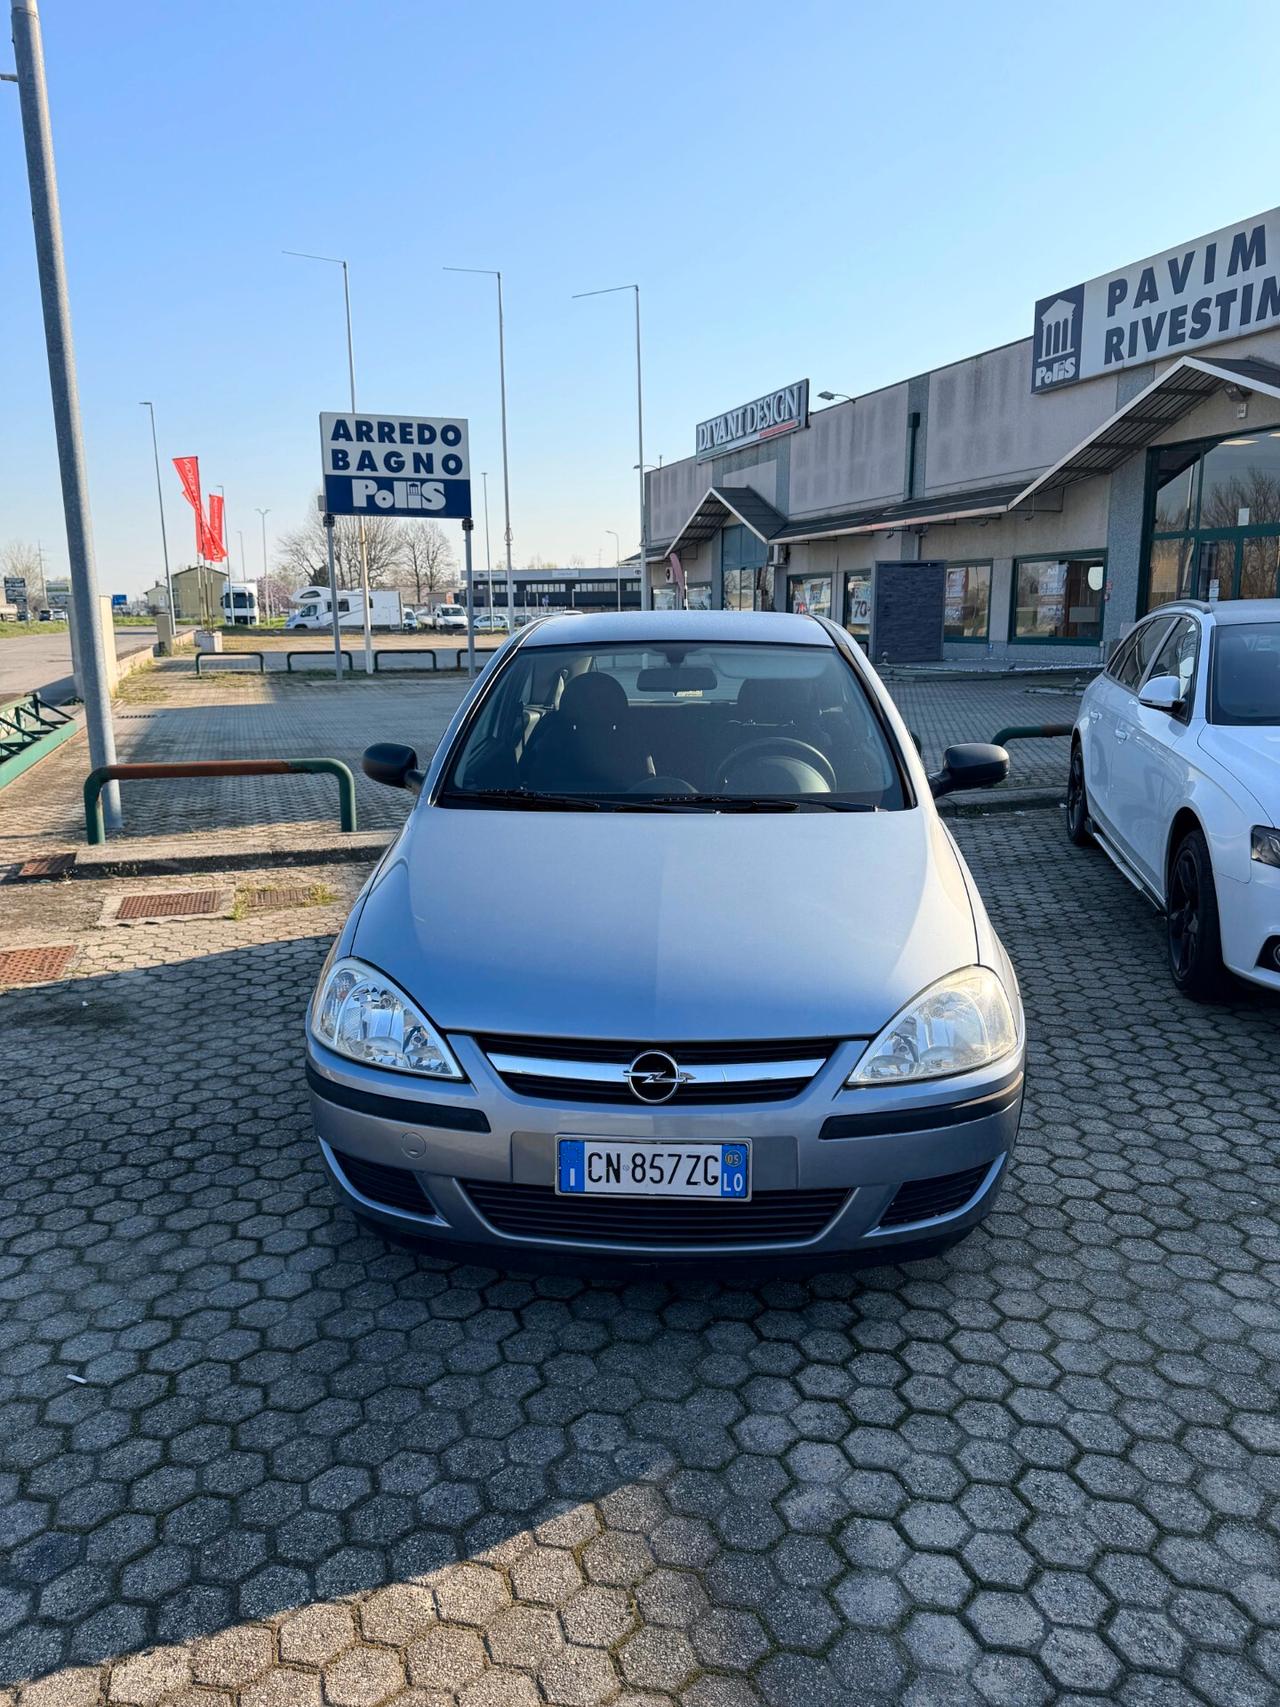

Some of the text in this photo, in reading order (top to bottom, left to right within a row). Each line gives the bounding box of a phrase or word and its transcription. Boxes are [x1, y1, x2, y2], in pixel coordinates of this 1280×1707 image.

[1106, 224, 1267, 318] PAVIM
[331, 419, 462, 447] ARREDO
[698, 385, 802, 451] DIVANI DESIGN
[331, 448, 463, 476] BAGNO
[569, 1152, 744, 1192] I CN 857ZG LO
